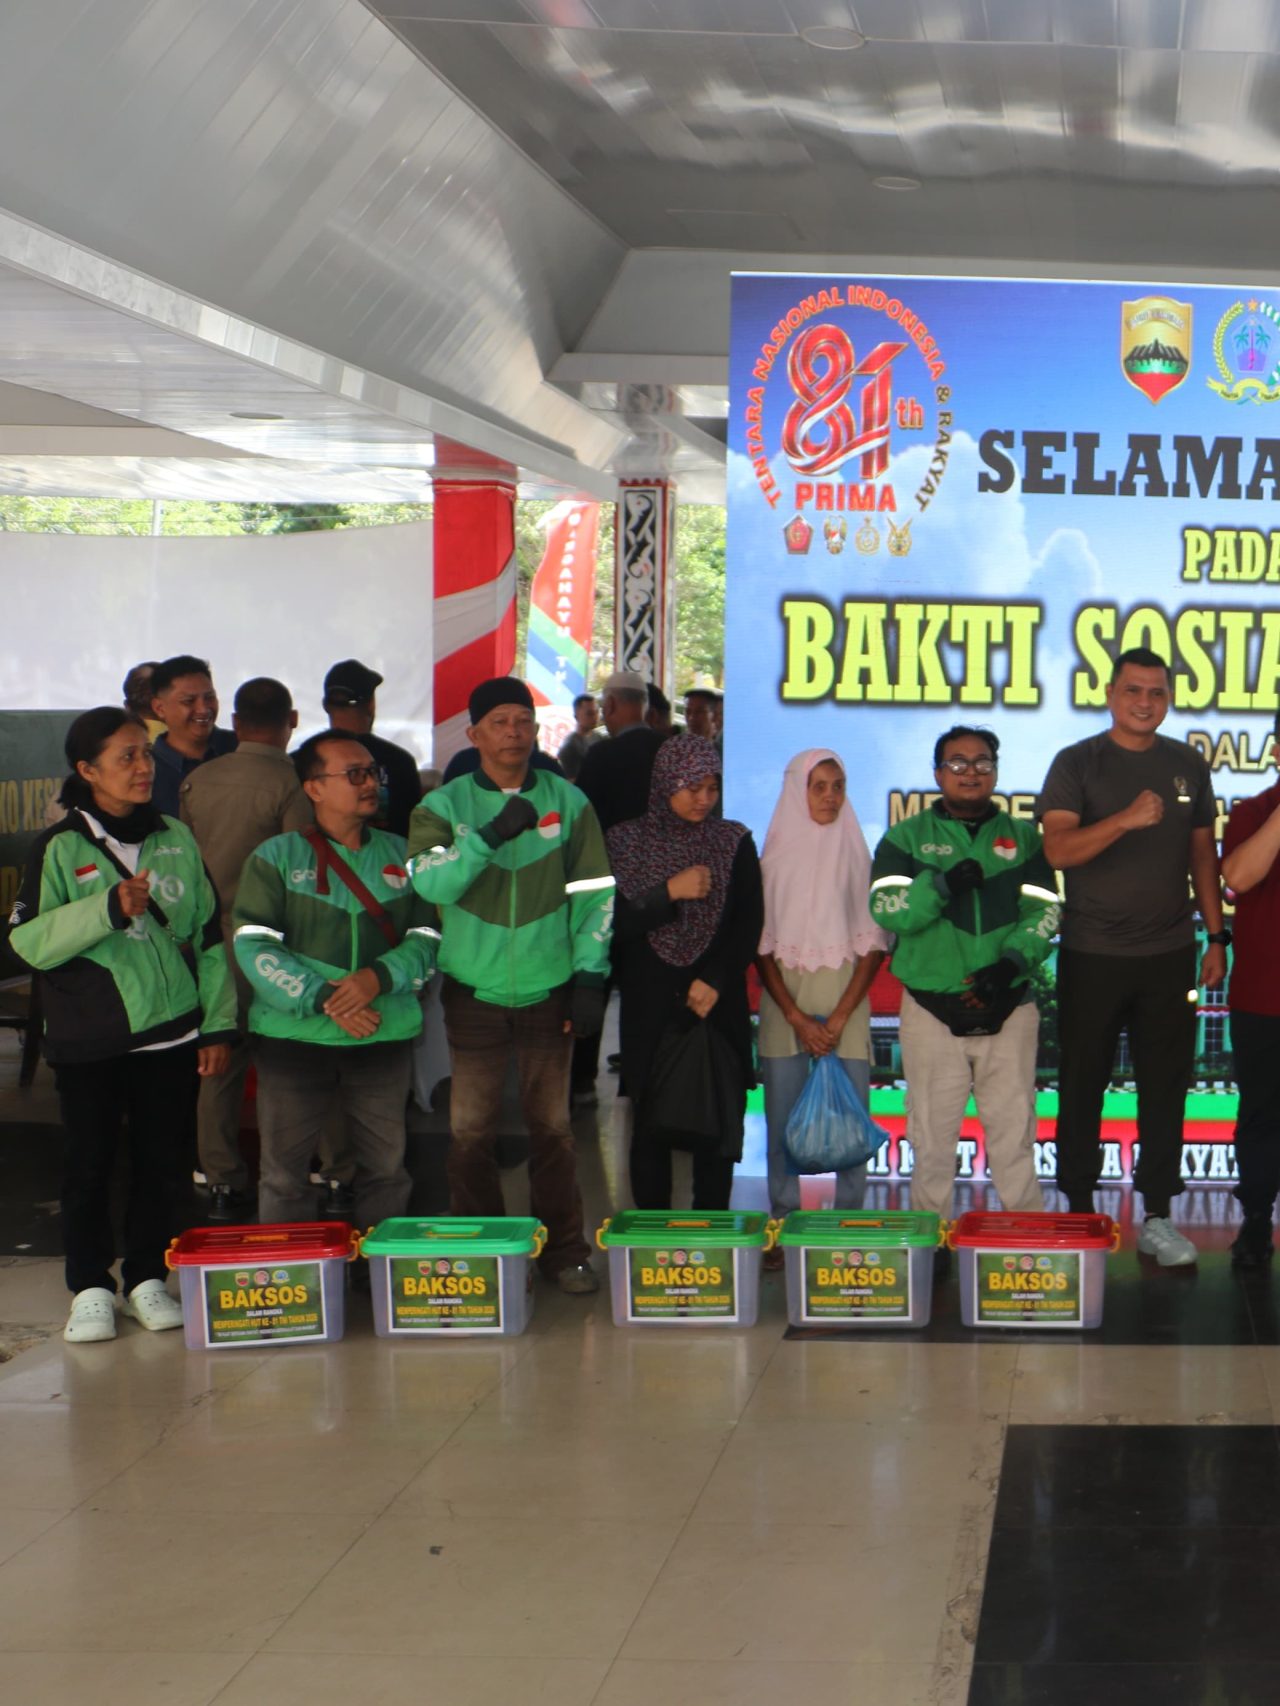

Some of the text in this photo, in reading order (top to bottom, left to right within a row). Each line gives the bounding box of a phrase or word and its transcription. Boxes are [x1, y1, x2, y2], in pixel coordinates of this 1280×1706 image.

[753, 287, 845, 381] NASIONAL
[848, 285, 946, 381] INDONESIA
[746, 386, 782, 509] TENTARA
[914, 411, 952, 512] RAKYAT
[795, 482, 898, 512] PRIMA
[782, 600, 1040, 704] BAKTI
[255, 953, 305, 997] Grab
[403, 1276, 487, 1296] BAKSOS
[641, 1266, 722, 1286] BAKSOS
[816, 1267, 896, 1286] BAKSOS
[988, 1271, 1068, 1290] BAKSOS
[220, 1284, 308, 1309] BAKSOS
